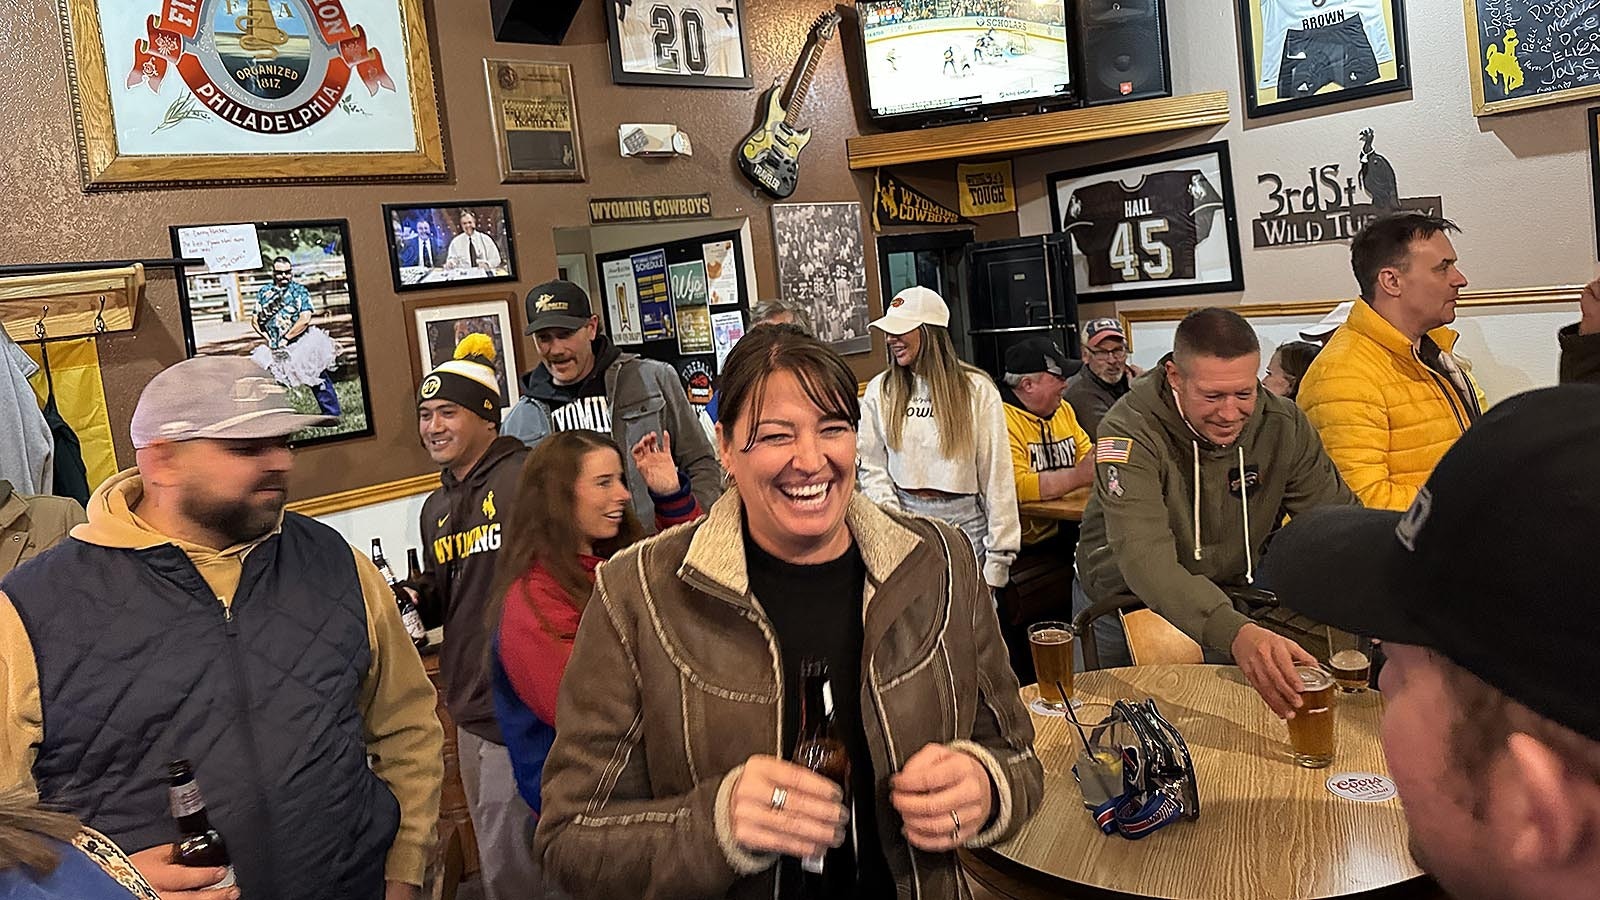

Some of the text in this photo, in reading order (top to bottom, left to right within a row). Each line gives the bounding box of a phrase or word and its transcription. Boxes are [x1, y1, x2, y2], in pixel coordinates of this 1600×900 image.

[1302, 9, 1345, 30] BROWN
[650, 4, 708, 75] 20
[236, 65, 299, 81] ORGANIZED
[1541, 58, 1599, 85] Jake
[968, 184, 1006, 206] TOUGH
[590, 198, 711, 220] WYOMING COWBOYS
[899, 203, 958, 223] COWBOYS
[1124, 197, 1153, 218] HALL
[1110, 218, 1174, 281] 45
